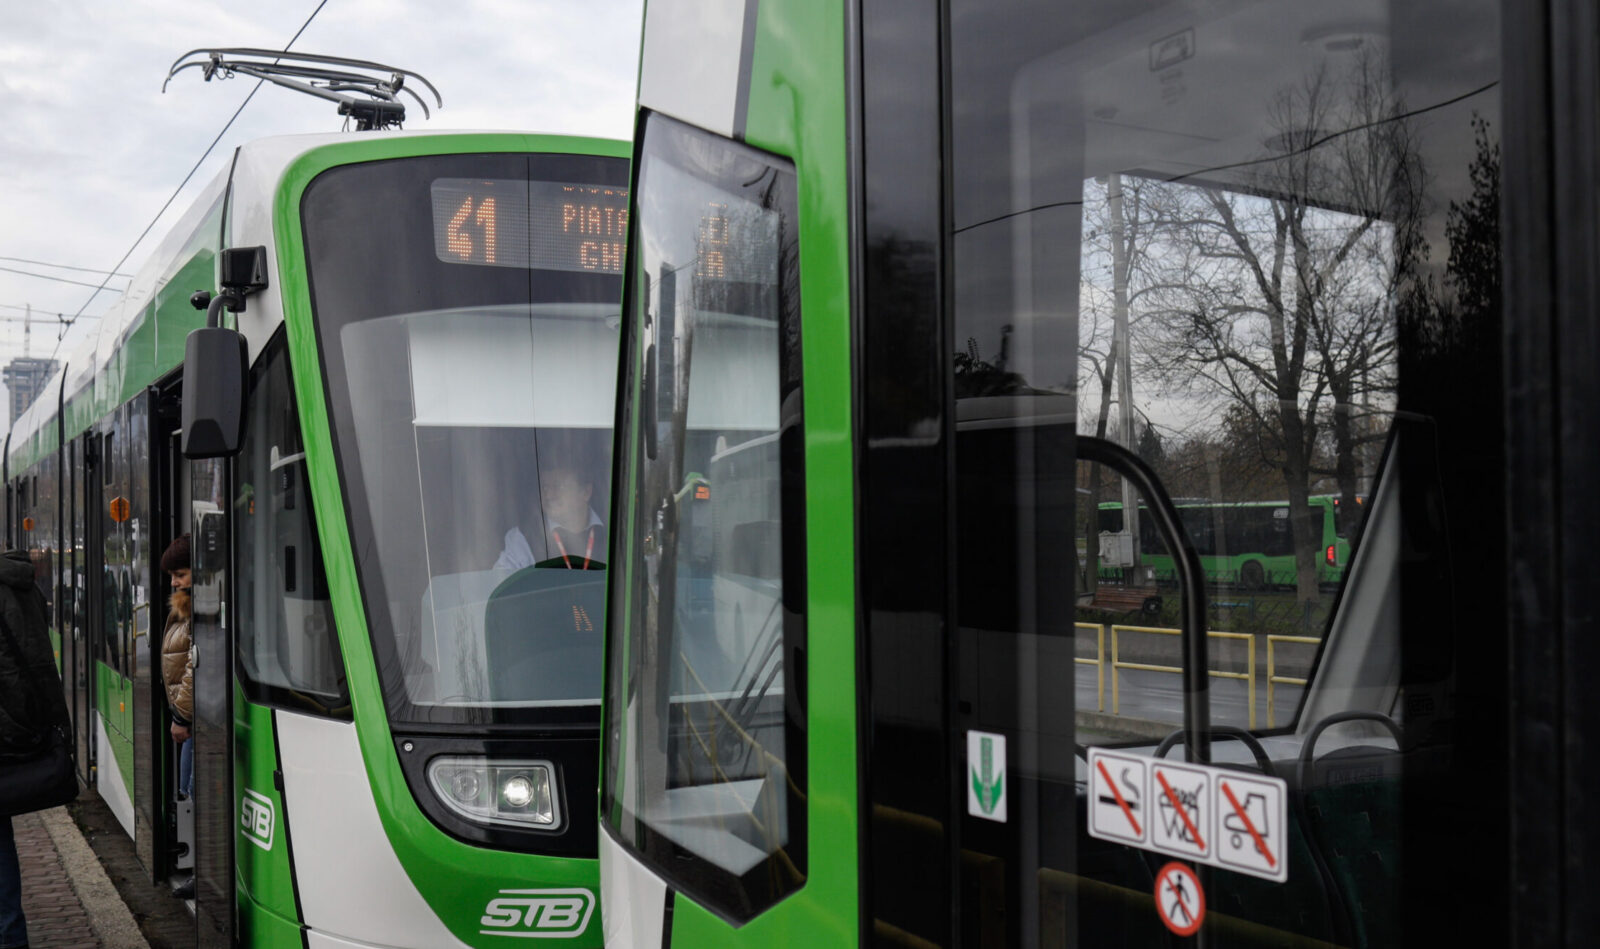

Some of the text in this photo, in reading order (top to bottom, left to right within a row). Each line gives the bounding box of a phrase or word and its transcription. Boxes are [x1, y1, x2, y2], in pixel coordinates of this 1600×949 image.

[448, 196, 496, 264] 41
[563, 204, 628, 236] PIATA
[581, 240, 628, 271] GH
[241, 796, 271, 839] STB
[480, 898, 584, 928] STB
